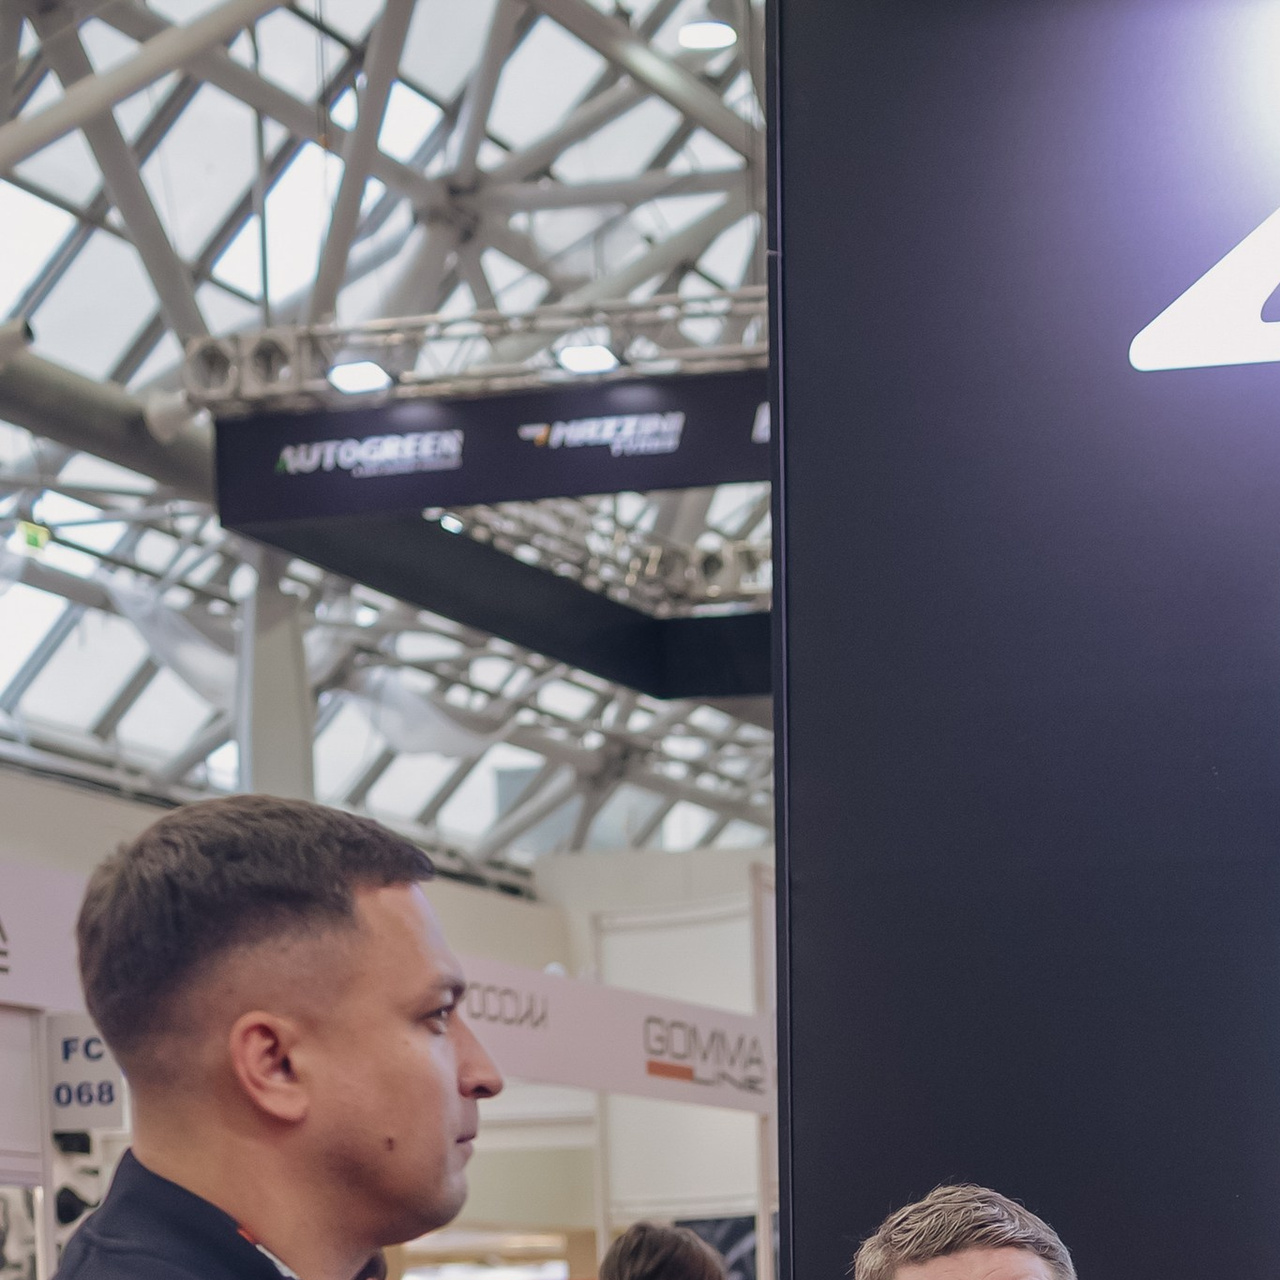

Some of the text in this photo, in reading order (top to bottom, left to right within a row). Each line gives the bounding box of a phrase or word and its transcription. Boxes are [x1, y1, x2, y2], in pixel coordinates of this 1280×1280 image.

[61, 1036, 103, 1062] FC
[643, 1015, 766, 1069] GOMMA
[54, 1080, 115, 1107] 068
